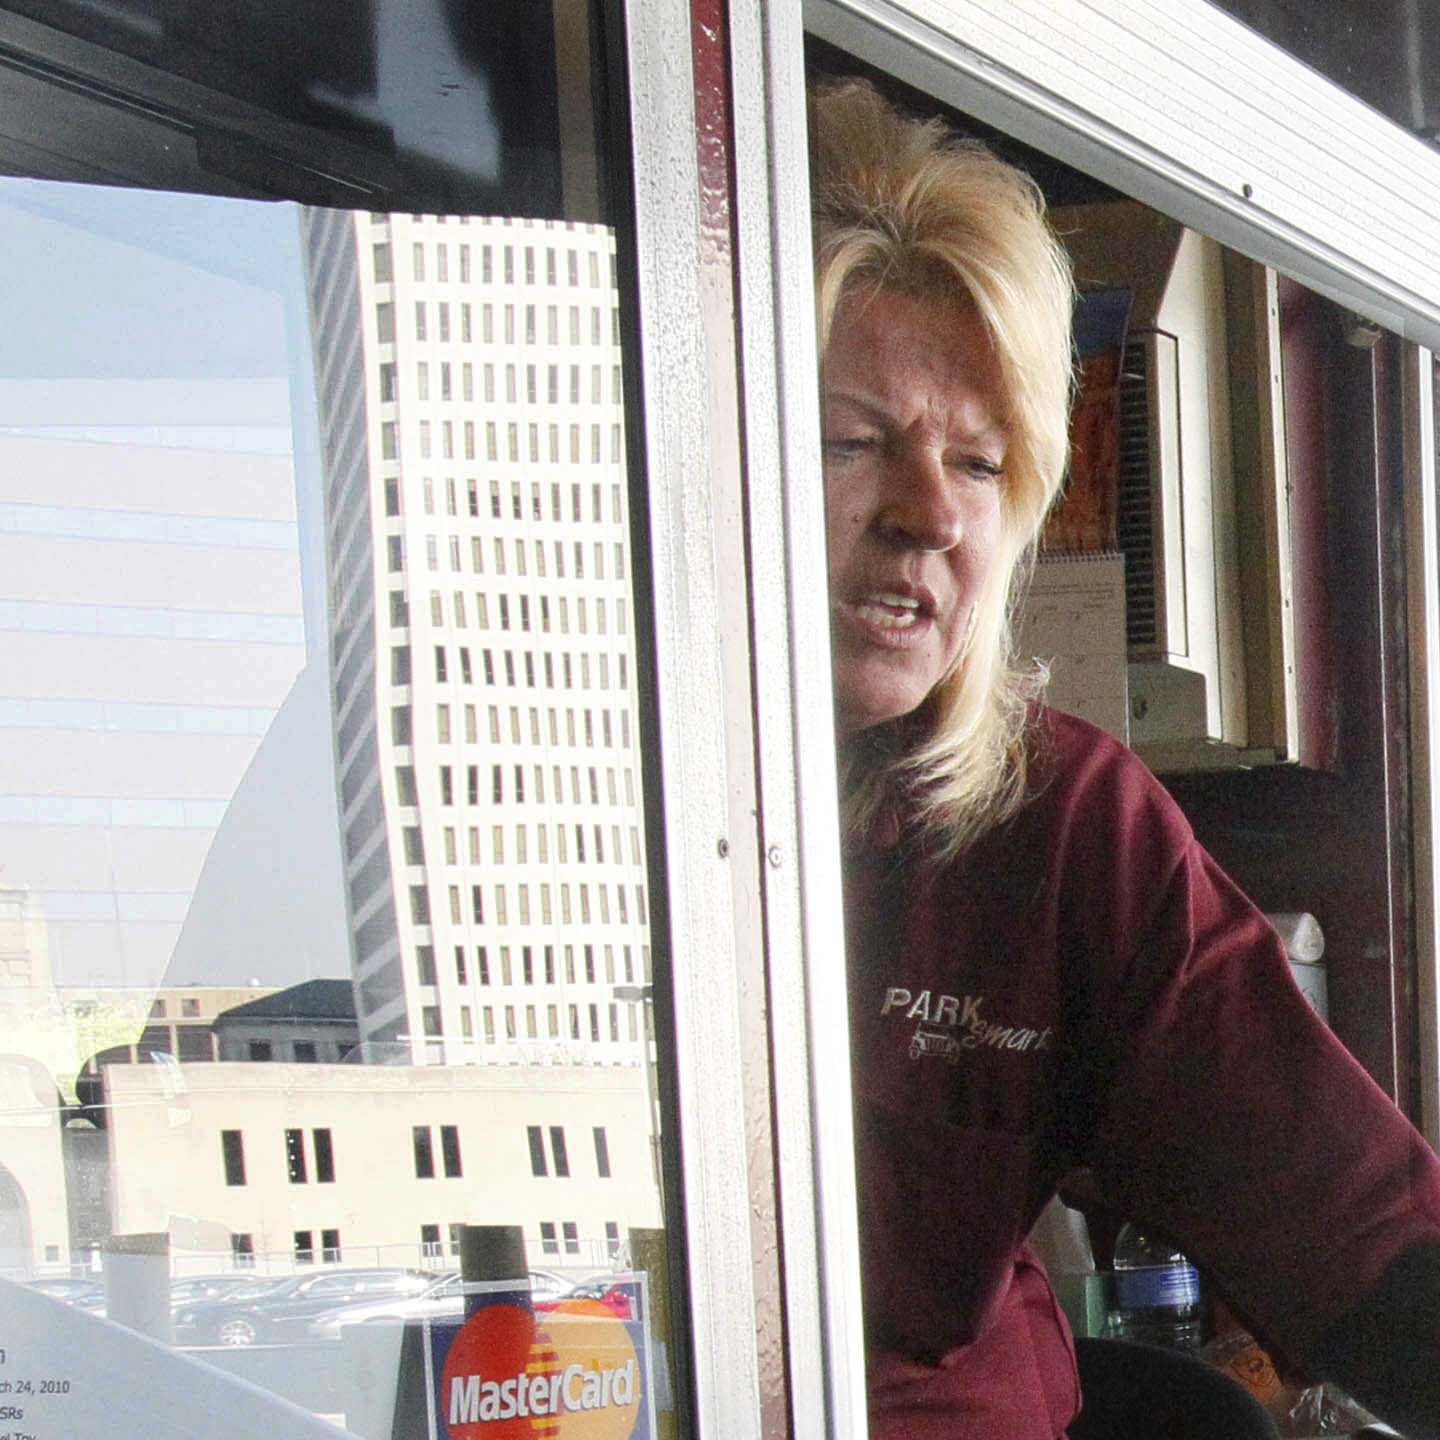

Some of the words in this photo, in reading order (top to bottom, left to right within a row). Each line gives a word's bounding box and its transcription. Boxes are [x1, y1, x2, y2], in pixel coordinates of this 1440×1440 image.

[880, 986, 984, 1026] PARK
[16, 1380, 35, 1395] 24,
[40, 1380, 71, 1394] 2010
[450, 1359, 635, 1425] MasterCard
